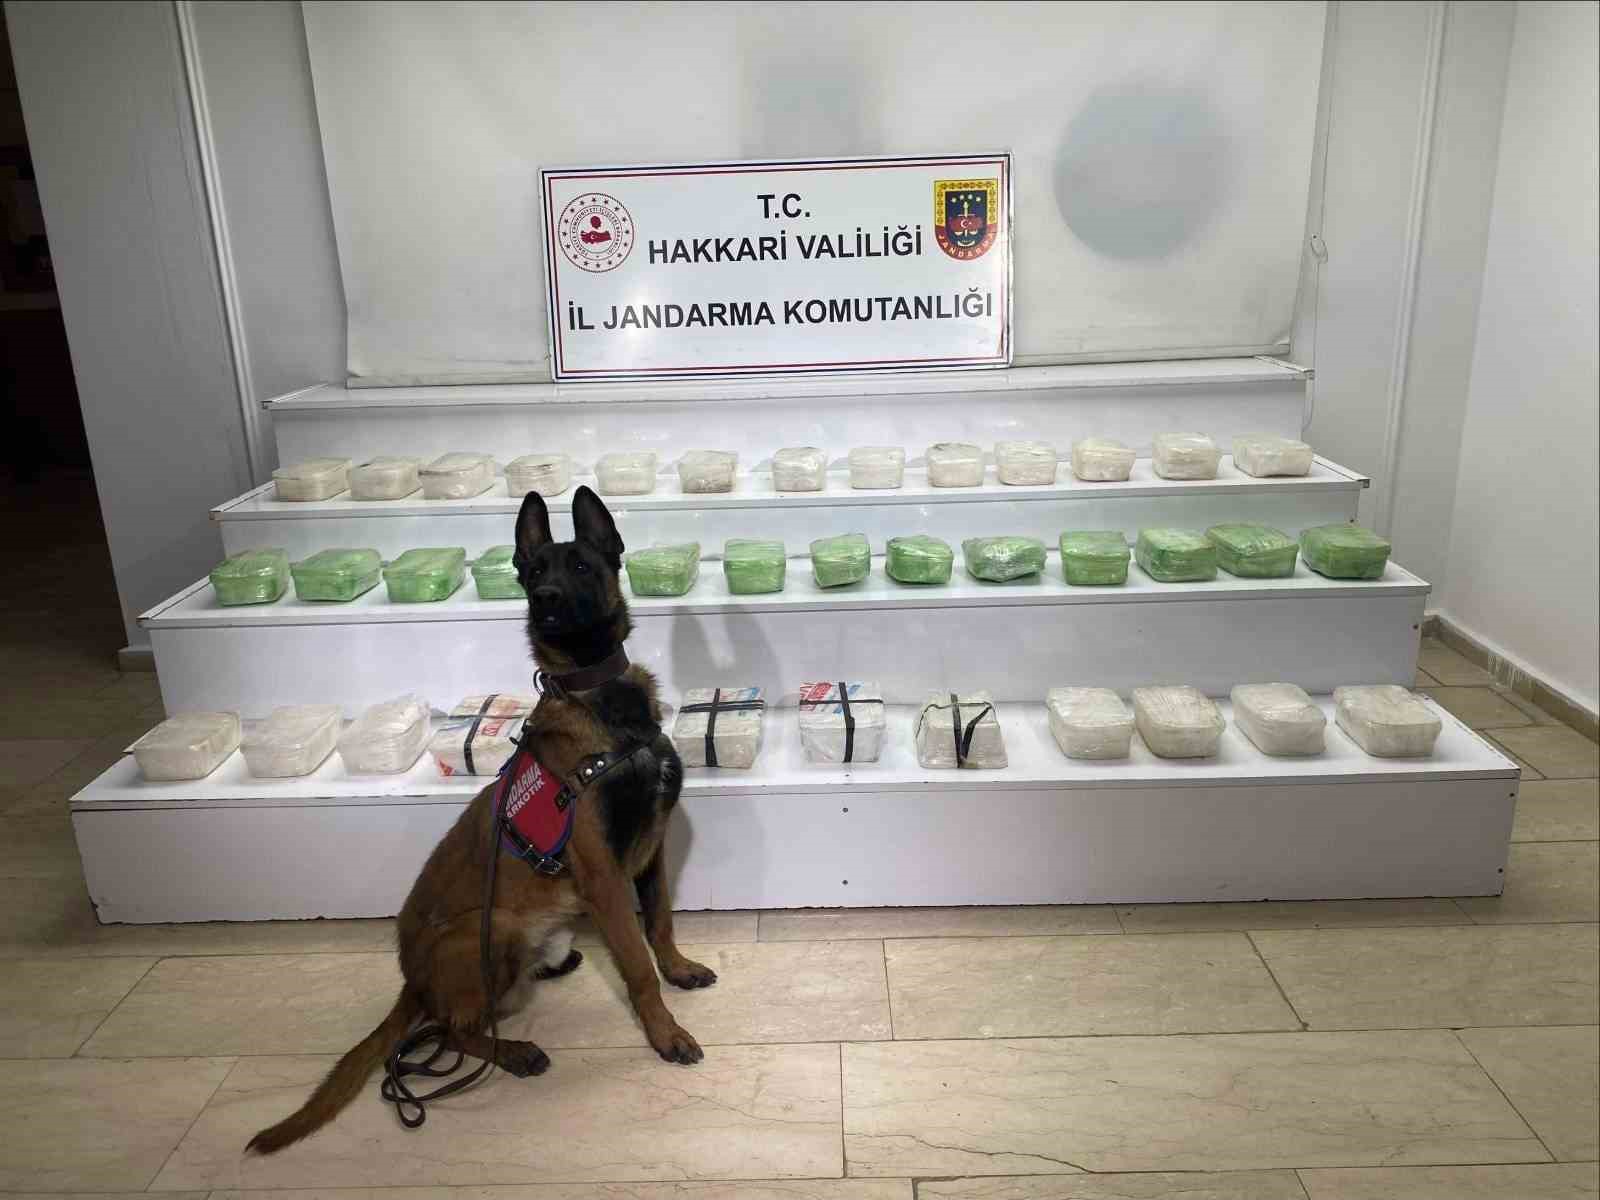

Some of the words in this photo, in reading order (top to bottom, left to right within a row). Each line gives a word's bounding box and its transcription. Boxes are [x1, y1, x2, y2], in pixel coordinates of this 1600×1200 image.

[756, 193, 811, 219] T.C.
[648, 229, 788, 265] HAKKARİ
[795, 224, 922, 260] VALİLİĞİ
[568, 300, 595, 331] İL
[603, 300, 777, 330] JANDARMA
[783, 287, 992, 327] KOMUTANLIĞI
